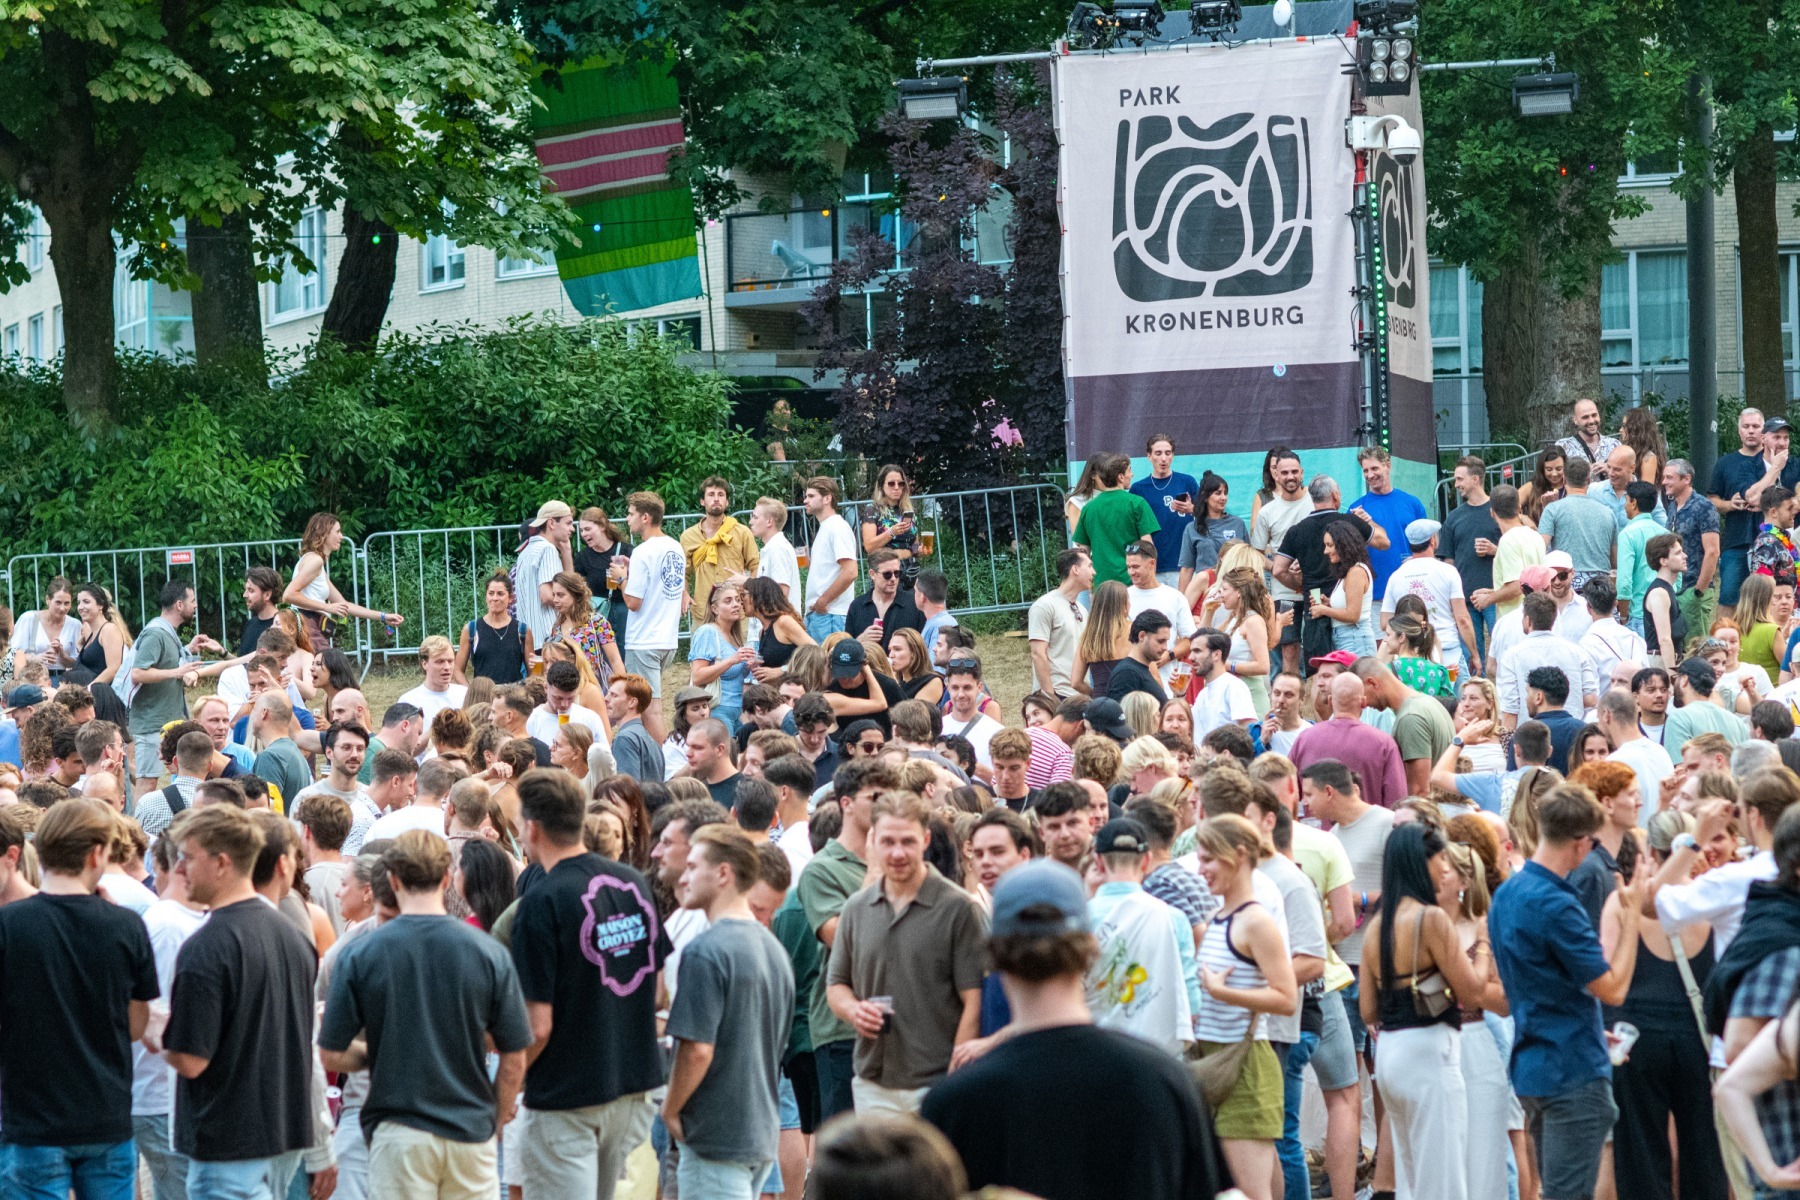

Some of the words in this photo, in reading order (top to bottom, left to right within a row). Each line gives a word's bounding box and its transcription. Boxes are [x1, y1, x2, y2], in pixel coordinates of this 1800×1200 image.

[1119, 85, 1181, 108] PARK
[1126, 306, 1304, 334] KRONENBURG
[596, 913, 642, 936] MAISON
